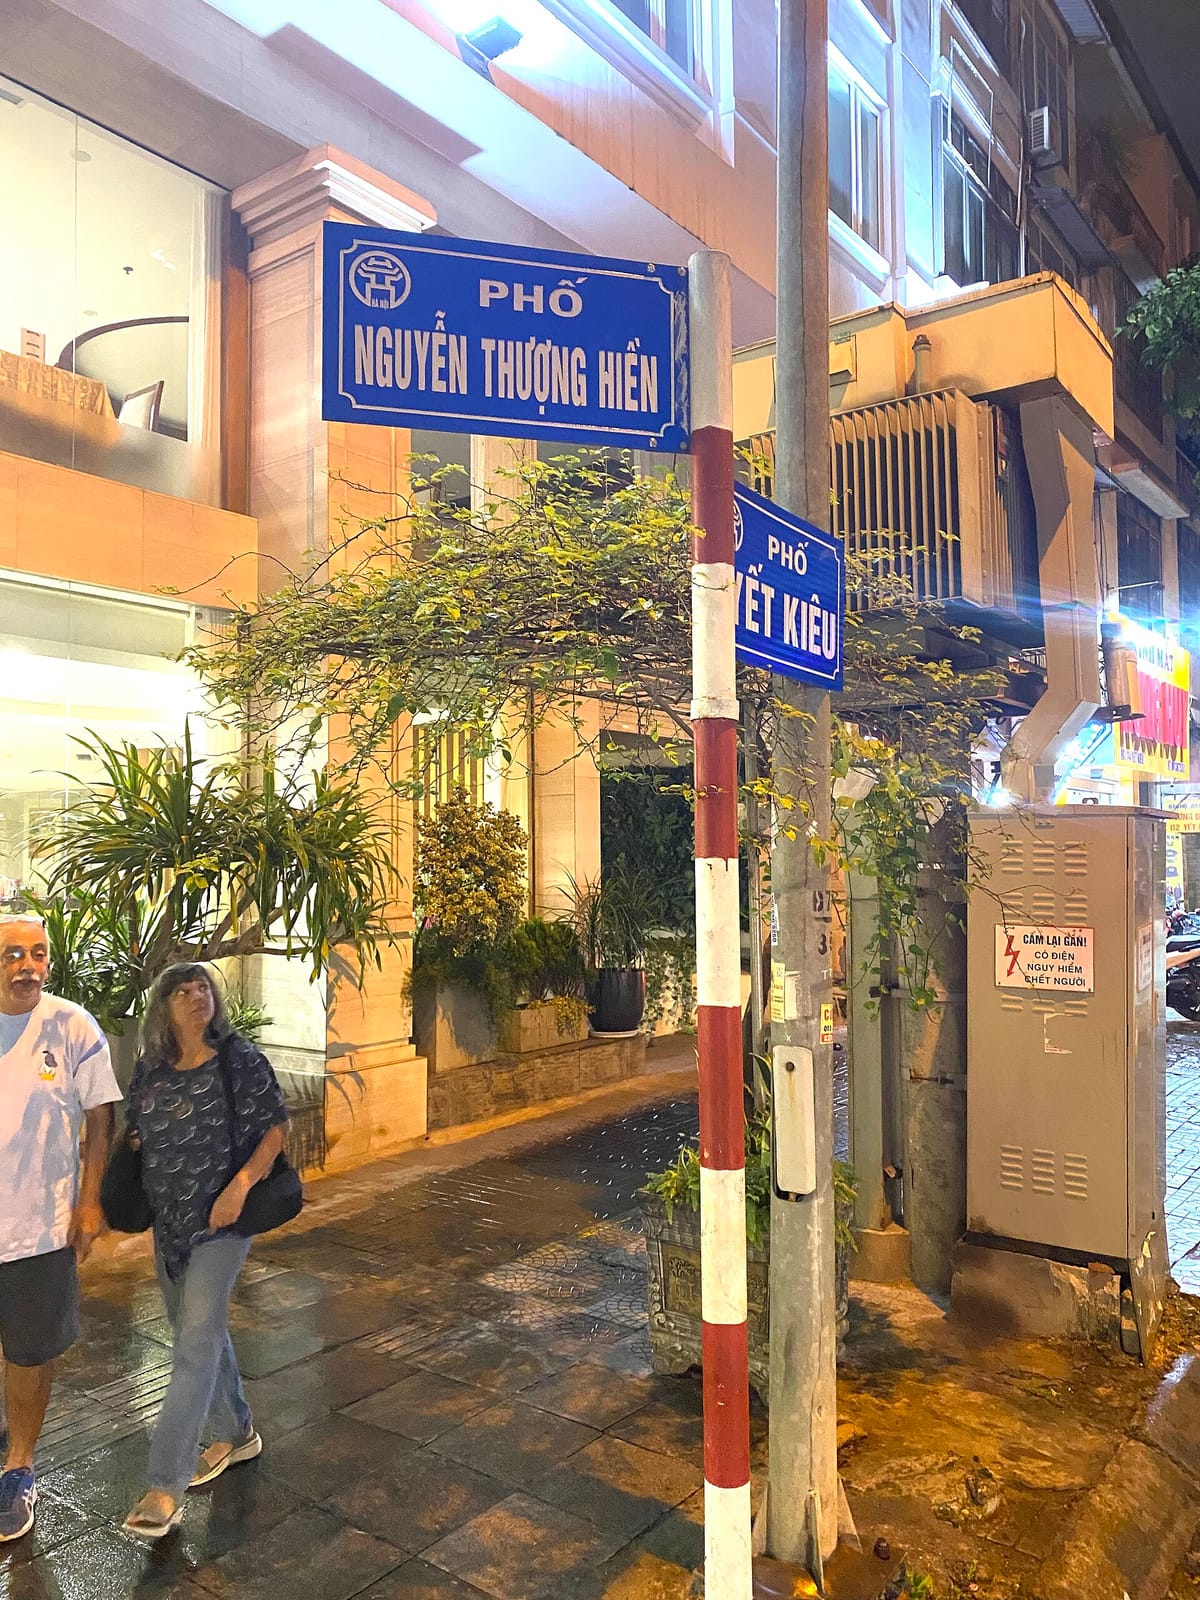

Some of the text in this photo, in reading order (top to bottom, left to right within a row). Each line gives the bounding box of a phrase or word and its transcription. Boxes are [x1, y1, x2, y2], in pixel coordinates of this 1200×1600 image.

[479, 277, 588, 318] PHỐ
[354, 310, 658, 415] NGUYỄN THƯỢNG HIỀN
[767, 534, 809, 576] PHỐ
[783, 593, 836, 660] KIÊU
[1034, 950, 1075, 962] CÓ ĐIỆN
[1046, 935, 1061, 948] LẠI
[1027, 961, 1083, 974] NGUY HIỂM
